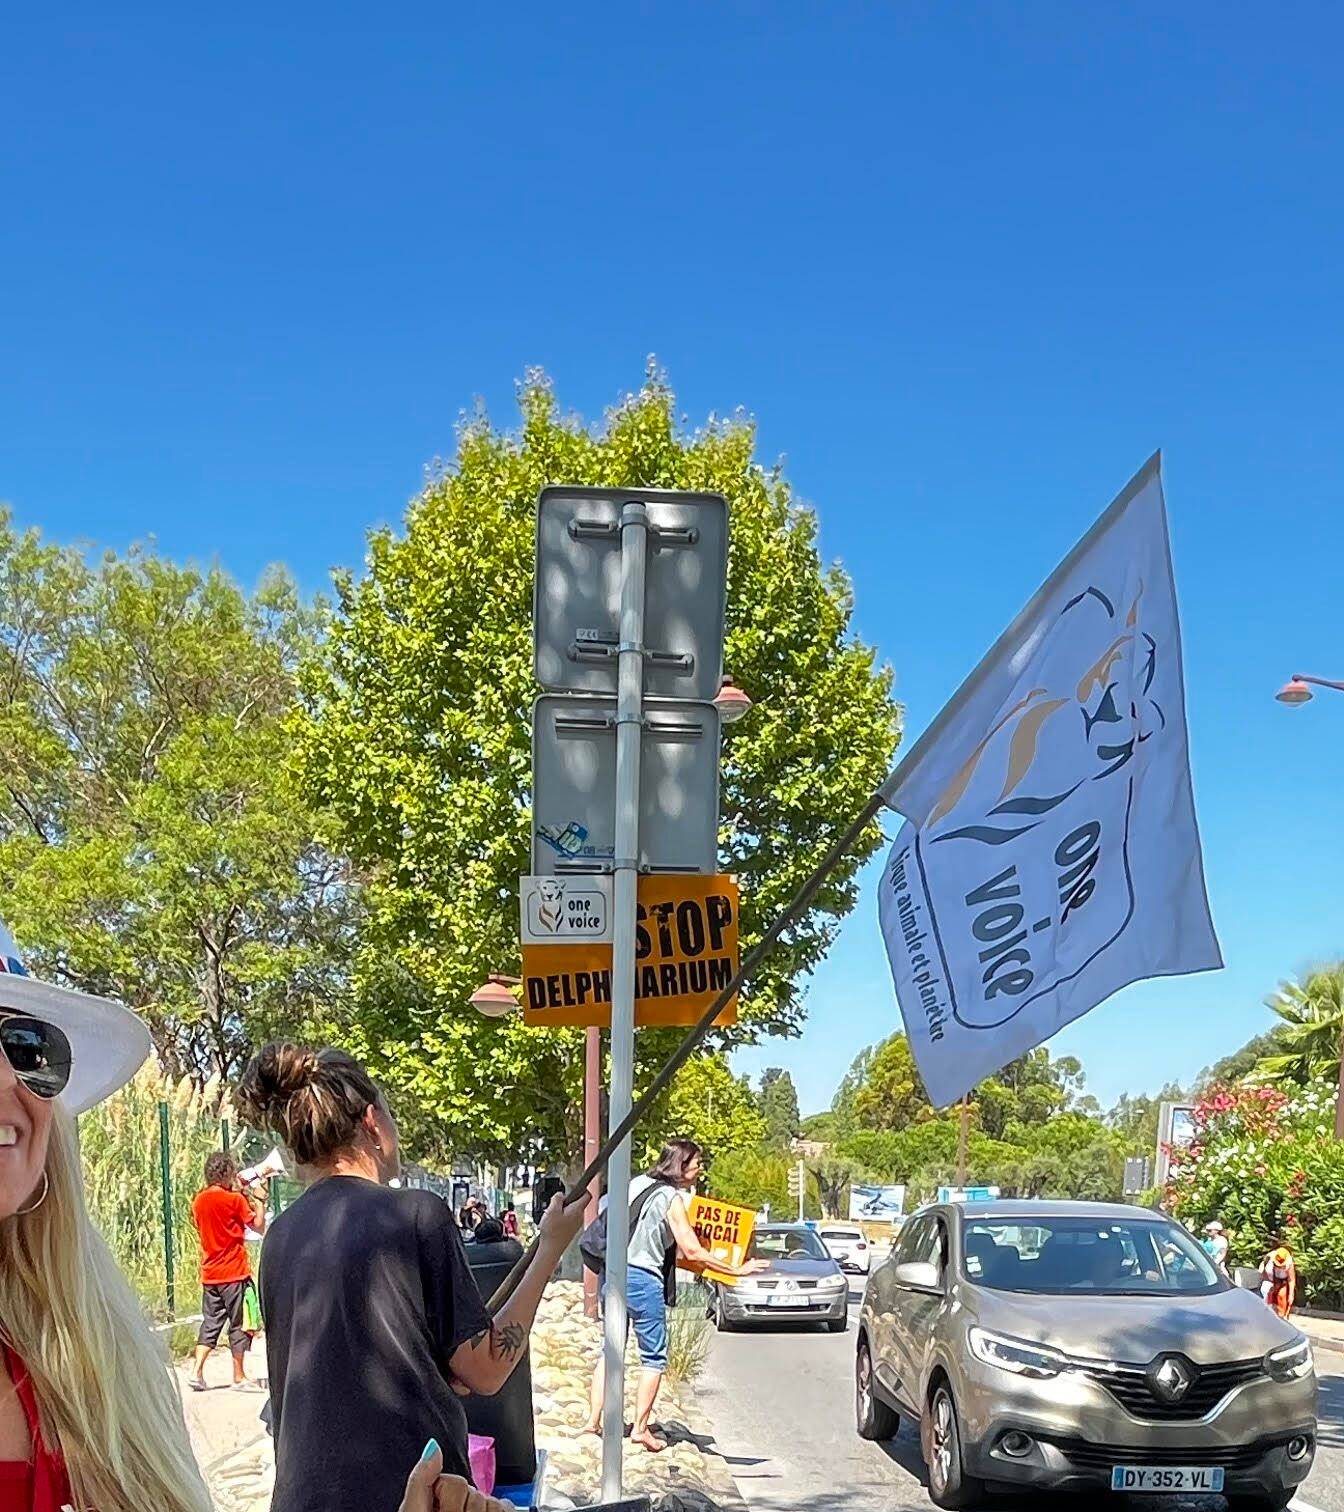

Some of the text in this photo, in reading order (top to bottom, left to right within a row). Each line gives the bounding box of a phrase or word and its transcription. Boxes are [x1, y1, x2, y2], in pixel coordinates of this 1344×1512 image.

[567, 899, 591, 912] one
[567, 912, 601, 928] voice
[635, 895, 732, 959] STOP
[964, 864, 1052, 1001] voice
[911, 953, 931, 973] et
[527, 957, 733, 1010] DELPHARIUM
[696, 1205, 742, 1226] PAS DE
[694, 1221, 740, 1244] BOCAL
[1124, 1470, 1211, 1488] DY-352-VL
